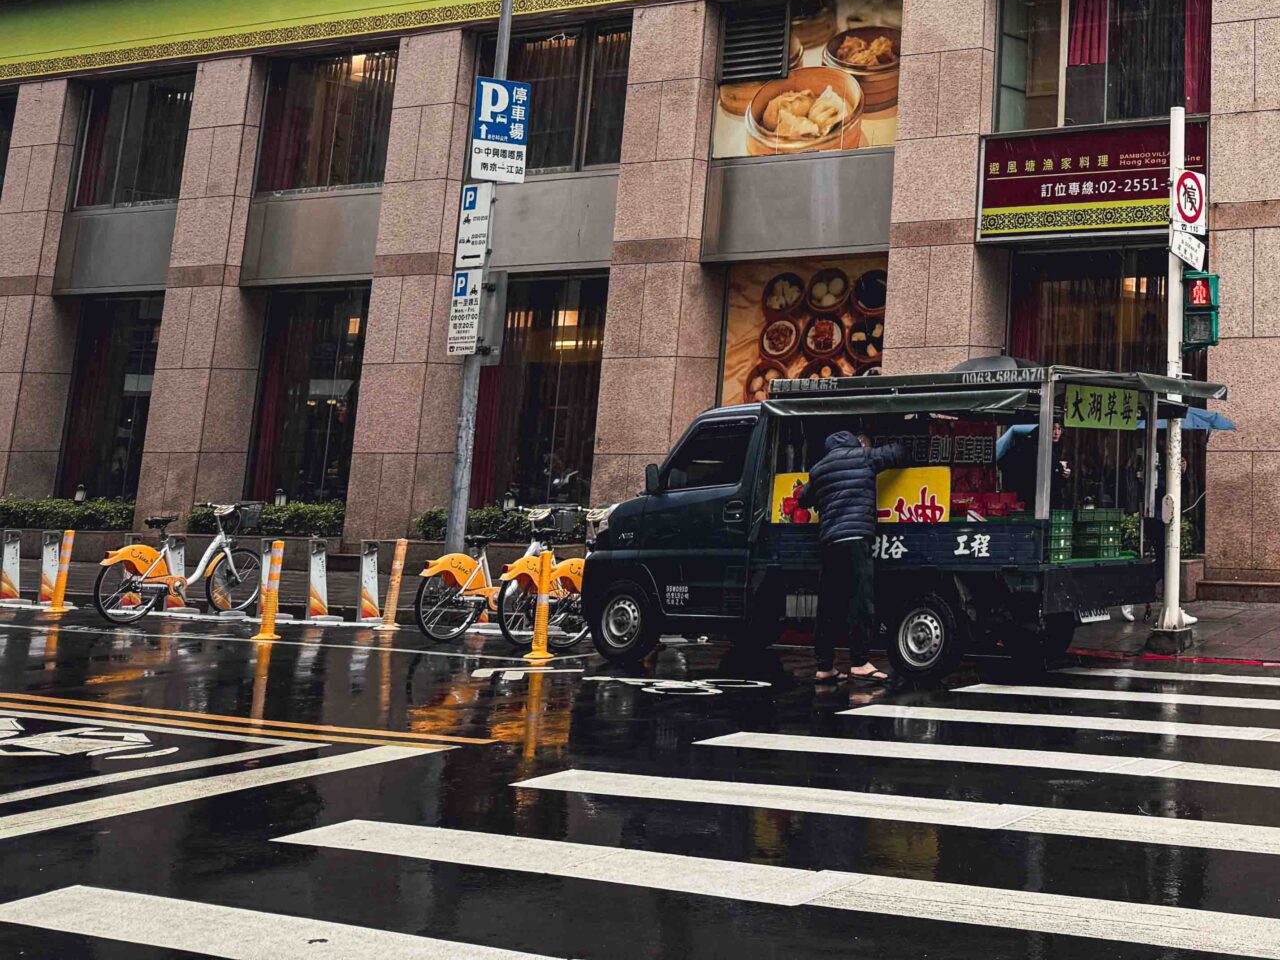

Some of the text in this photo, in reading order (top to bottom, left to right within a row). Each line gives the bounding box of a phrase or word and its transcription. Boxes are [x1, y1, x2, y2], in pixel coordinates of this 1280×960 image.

[478, 81, 510, 123] P
[509, 86, 528, 140] 停車場
[988, 154, 1110, 175] 避風塘漁家料理
[1119, 152, 1151, 160] BAMBOO
[1119, 157, 1167, 166] Hong Kong
[465, 191, 475, 208] P
[456, 276, 466, 294] P
[1070, 390, 1134, 427] 大湖草莓
[953, 533, 991, 558] 工程
